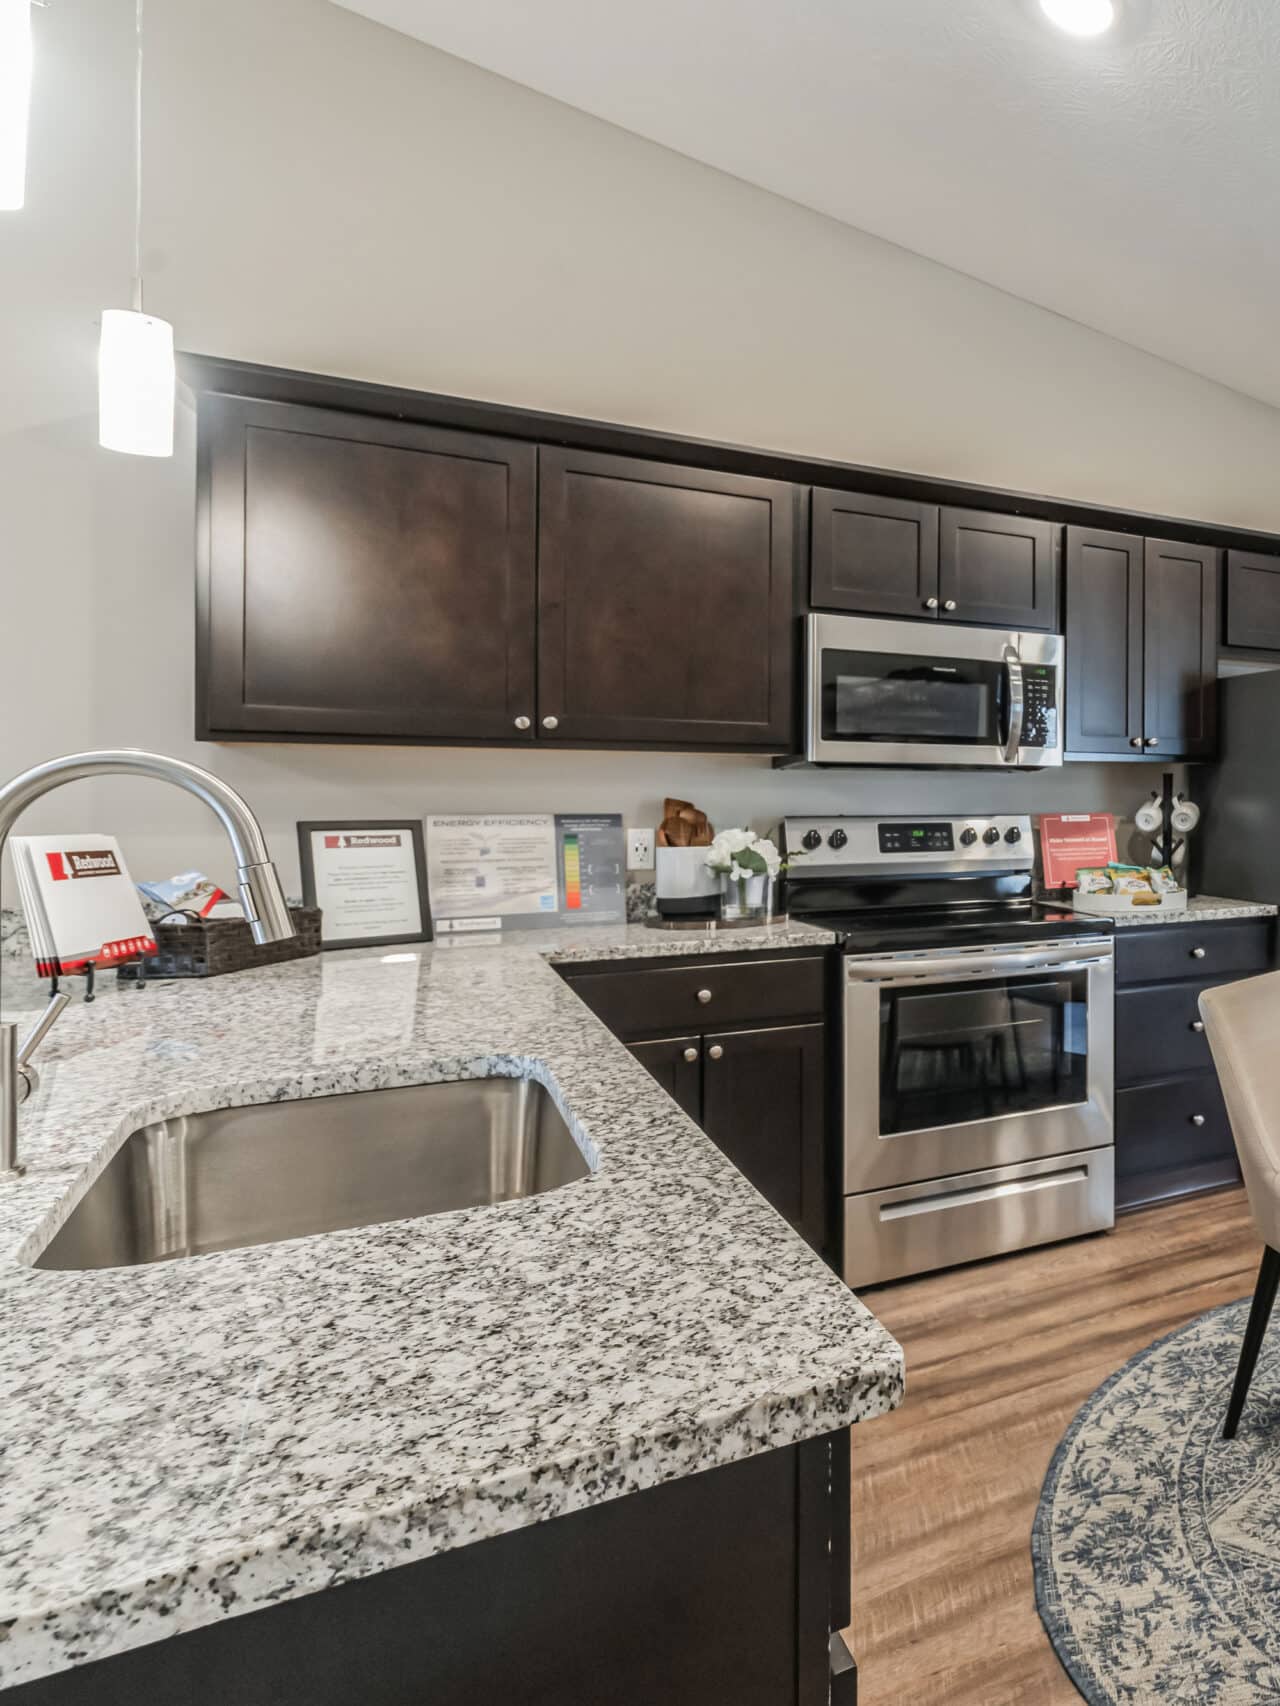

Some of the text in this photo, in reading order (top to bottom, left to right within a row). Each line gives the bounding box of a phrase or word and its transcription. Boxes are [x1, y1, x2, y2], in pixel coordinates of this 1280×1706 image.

[432, 818, 549, 827] ENERGY EFFICIENCY
[350, 836, 397, 845] Redwood
[72, 854, 116, 870] Redwood
